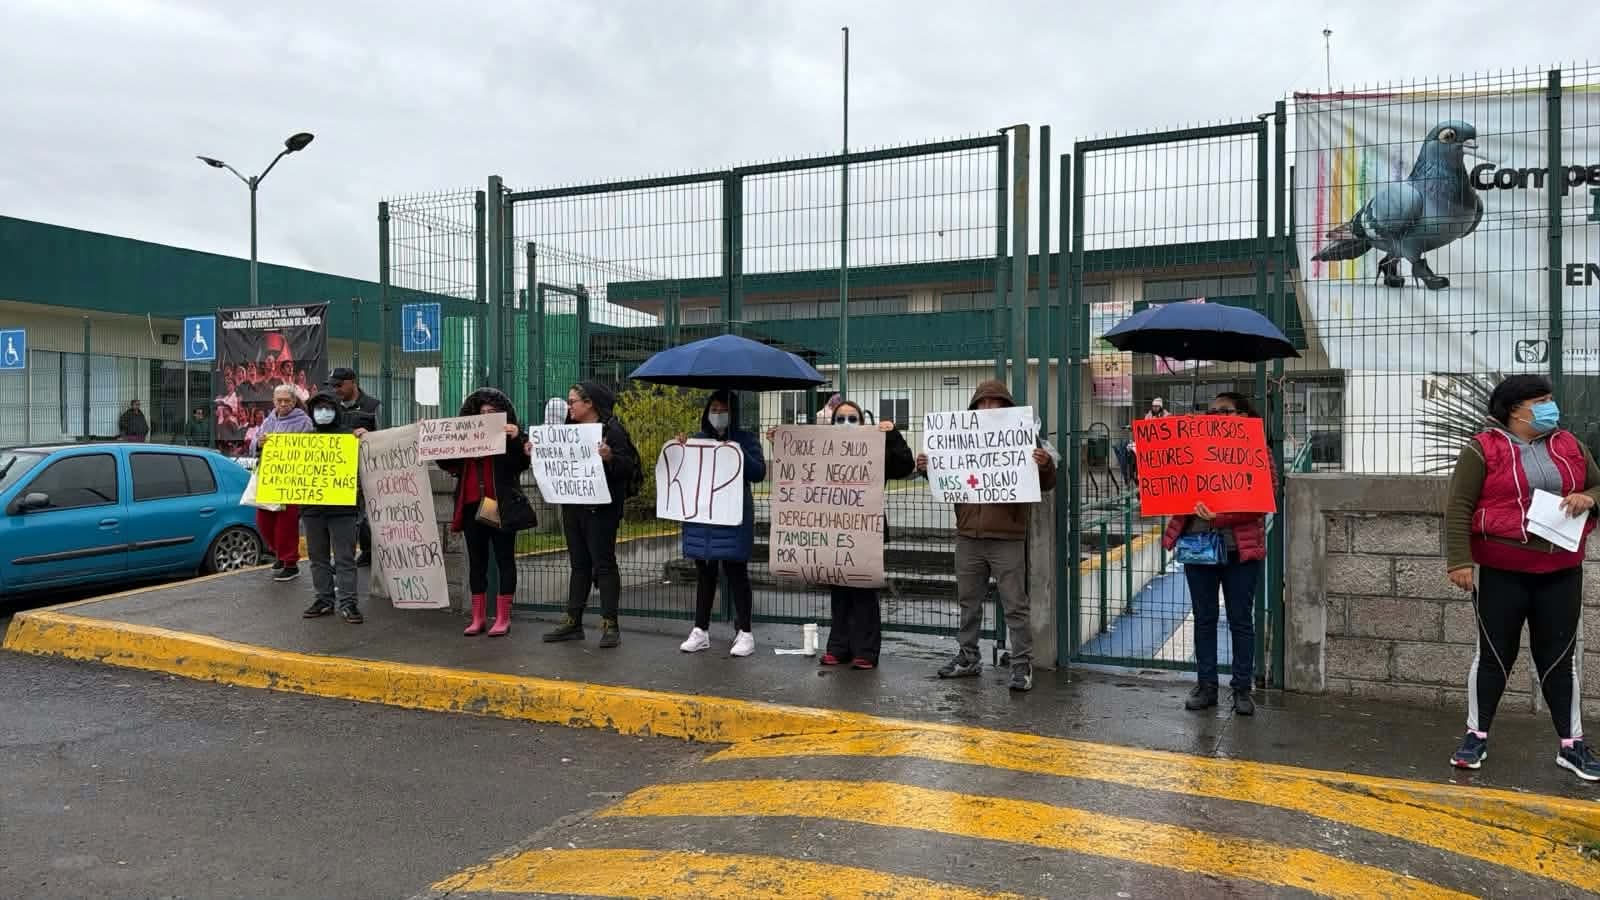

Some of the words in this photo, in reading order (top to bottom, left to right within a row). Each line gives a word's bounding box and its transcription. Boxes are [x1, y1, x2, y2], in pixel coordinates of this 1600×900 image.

[422, 421, 436, 434] NO
[441, 421, 451, 432] TE
[927, 414, 943, 430] NO
[950, 413, 957, 430] A
[961, 412, 979, 430] LA
[473, 432, 486, 440] NO
[532, 430, 544, 444] SI
[927, 421, 1033, 449] CRIMINALIZACIÓN
[1137, 422, 1171, 443] MAS
[267, 436, 326, 449] SERVICIOS
[329, 436, 342, 449] DE
[822, 440, 834, 456] LA
[840, 440, 868, 456] SALUD
[265, 449, 300, 461] SALUD
[535, 447, 563, 459] PUDIERA
[570, 447, 576, 460] A
[581, 446, 591, 459] SU
[1140, 446, 1194, 468] MEJORES
[262, 463, 336, 476] CONDICIONES
[544, 460, 578, 478] MADRE
[584, 464, 596, 478] LA
[932, 456, 945, 470] DE
[262, 476, 328, 488] LABORALES
[333, 474, 355, 488] MÁS
[801, 463, 816, 482] SE
[939, 475, 962, 490] IMSS
[983, 470, 1018, 488] DIGNO
[552, 480, 595, 497] VENDIERA
[1142, 474, 1188, 496] RETIRO
[1196, 471, 1253, 493] DIGNO!
[275, 488, 324, 501] JUSTAS
[779, 487, 796, 502] SE
[803, 487, 865, 507] DEFIENDE
[944, 491, 969, 503] PARA
[975, 488, 1017, 502] TODOS
[778, 510, 884, 533] DERECHOHABIENTE
[776, 531, 828, 547] TAMBIEN
[836, 533, 855, 549] ES
[777, 548, 797, 564] POR
[835, 550, 855, 567] LA
[801, 565, 847, 584] LUCHA
[393, 576, 429, 601] IMSS
